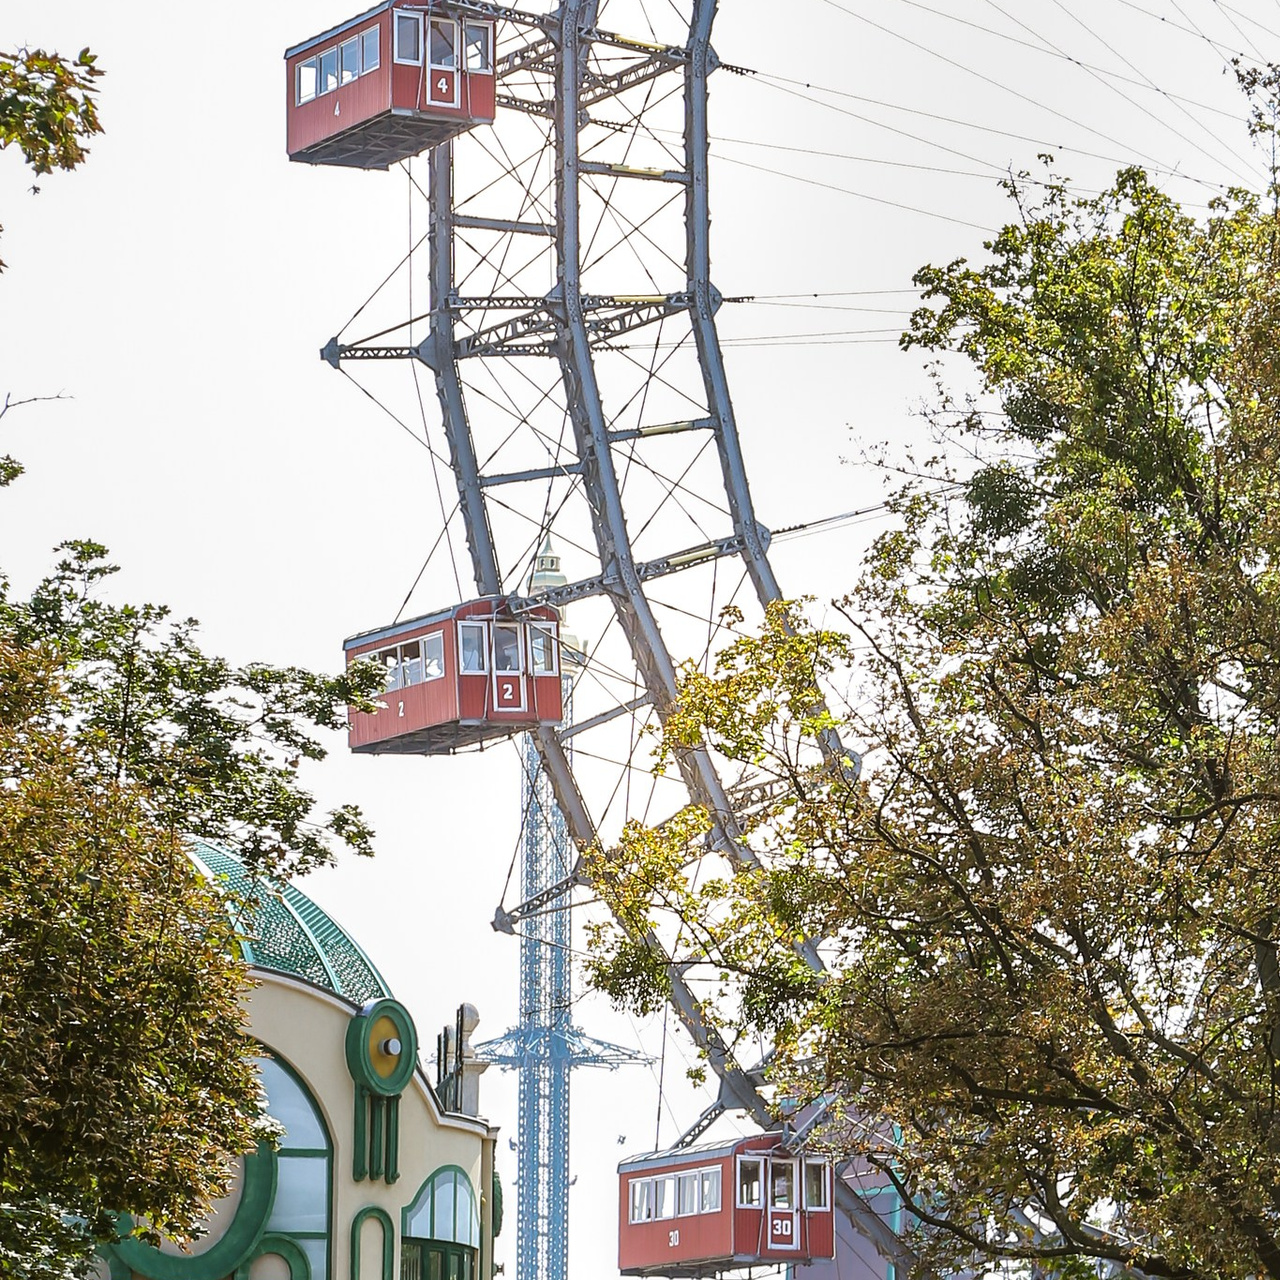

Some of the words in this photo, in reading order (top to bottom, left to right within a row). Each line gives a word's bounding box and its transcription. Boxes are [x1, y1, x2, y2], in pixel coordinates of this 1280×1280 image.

[437, 77, 448, 93] 4
[334, 100, 340, 117] 4
[502, 684, 513, 700] 2
[398, 701, 405, 717] 2
[773, 1220, 791, 1235] 30
[668, 1230, 679, 1247] 30
